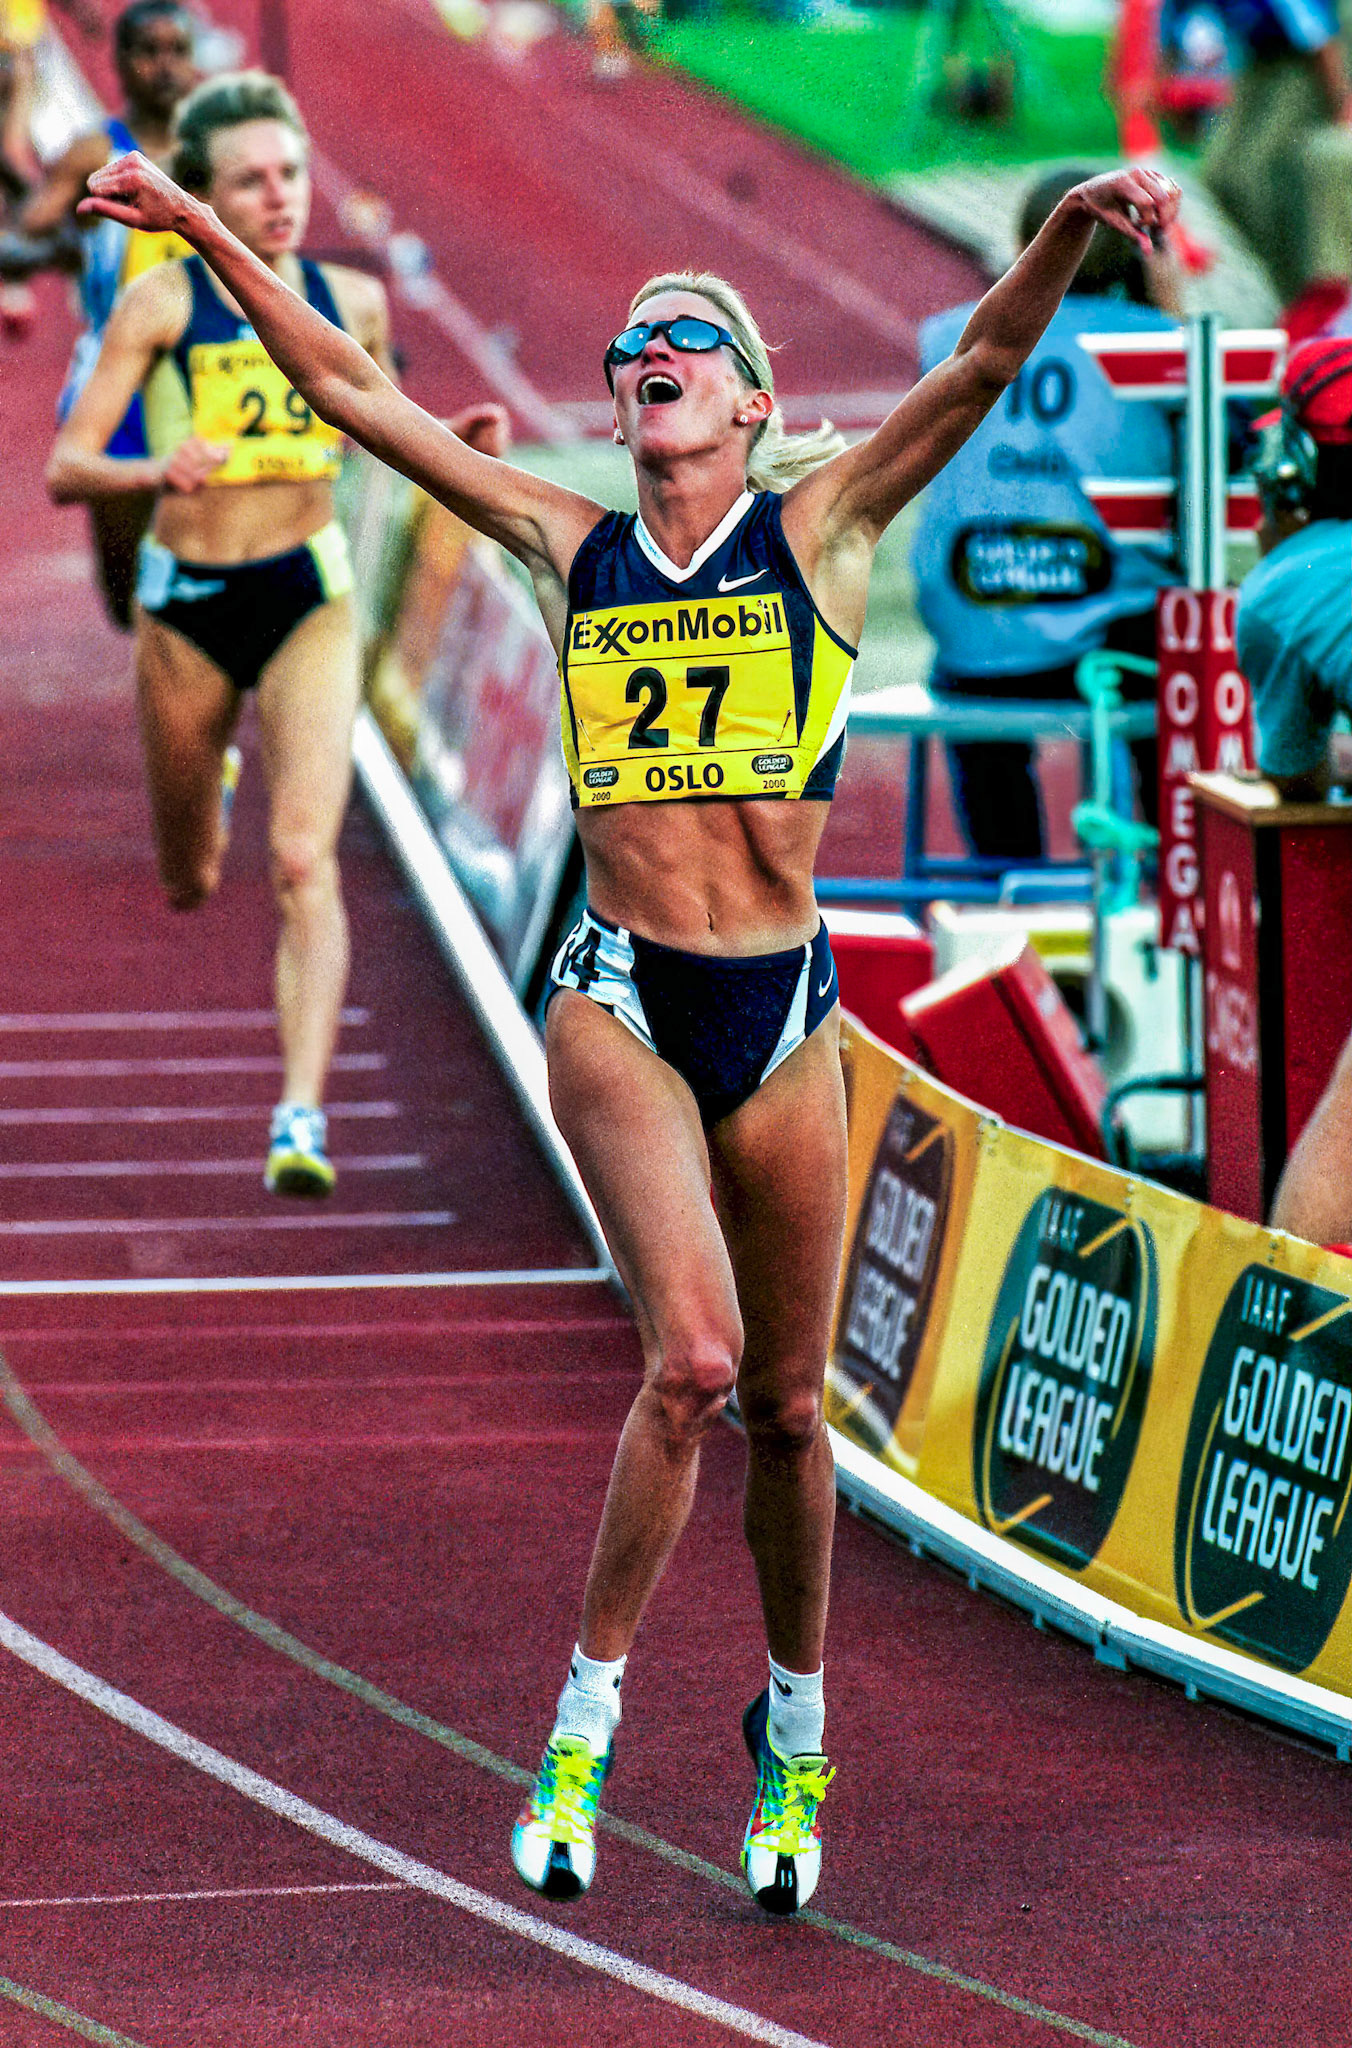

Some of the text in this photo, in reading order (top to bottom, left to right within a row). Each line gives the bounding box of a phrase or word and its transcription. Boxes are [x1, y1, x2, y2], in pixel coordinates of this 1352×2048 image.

[238, 386, 312, 438] 29
[572, 602, 784, 656] ExxonMobil
[625, 666, 730, 750] 27
[591, 791, 611, 802] 2000
[645, 763, 724, 792] OSLO
[763, 779, 786, 789] 2000
[1164, 671, 1200, 954] OMEGA
[1020, 1264, 1131, 1389] GOLDEN
[1000, 1366, 1113, 1492] LEAGUE
[1223, 1346, 1352, 1482] GOLDEN
[1202, 1451, 1334, 1591] LEAGUE
